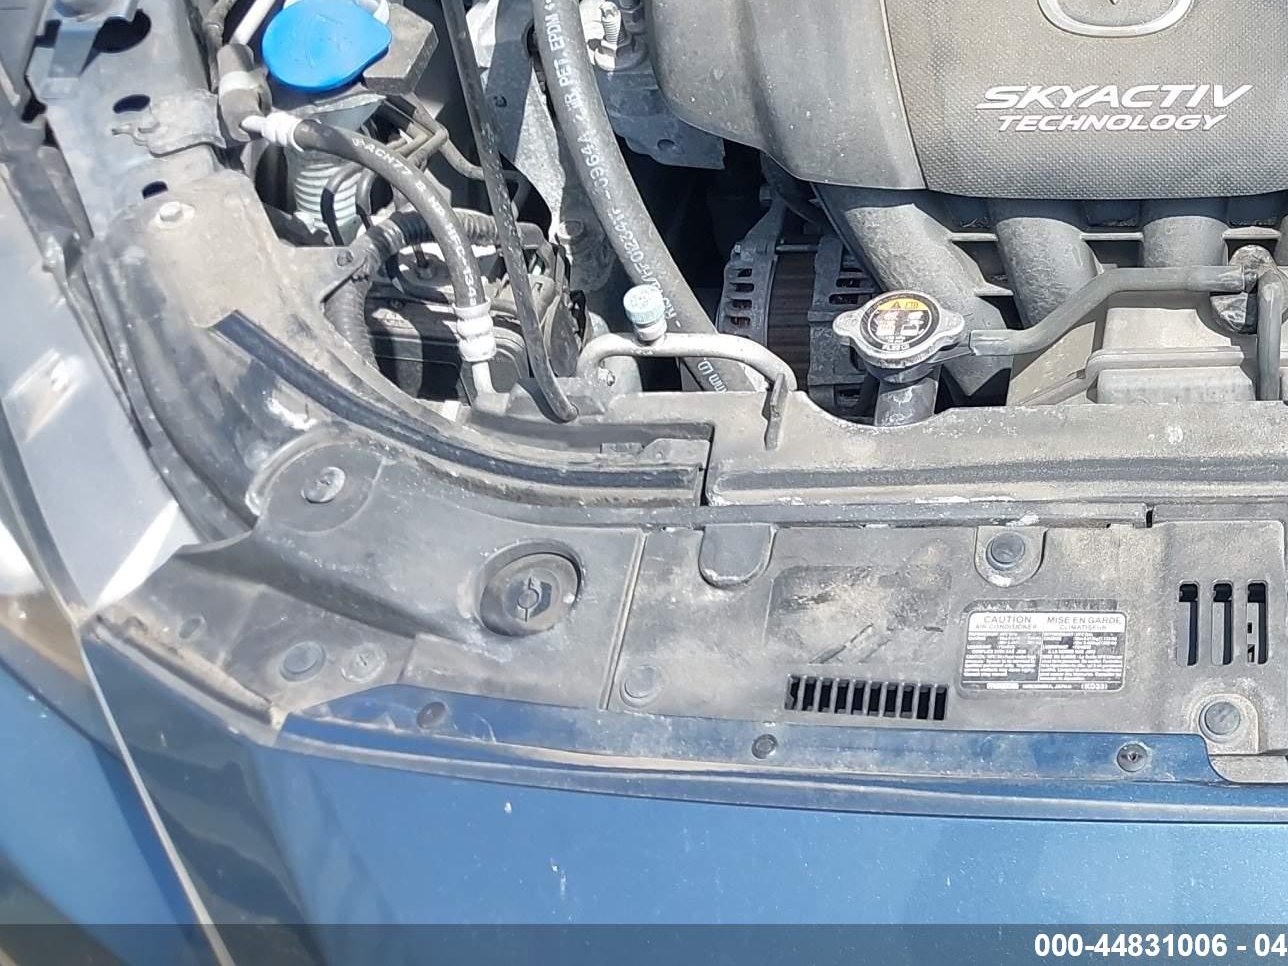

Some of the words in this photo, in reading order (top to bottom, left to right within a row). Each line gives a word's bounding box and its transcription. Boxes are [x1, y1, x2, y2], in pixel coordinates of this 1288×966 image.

[545, 14, 565, 51] EPDM
[976, 84, 1254, 110] SKYACTIV
[997, 114, 1229, 132] TECHNOLOGY
[984, 615, 1032, 624] CAUTION
[1047, 616, 1070, 624] MISE
